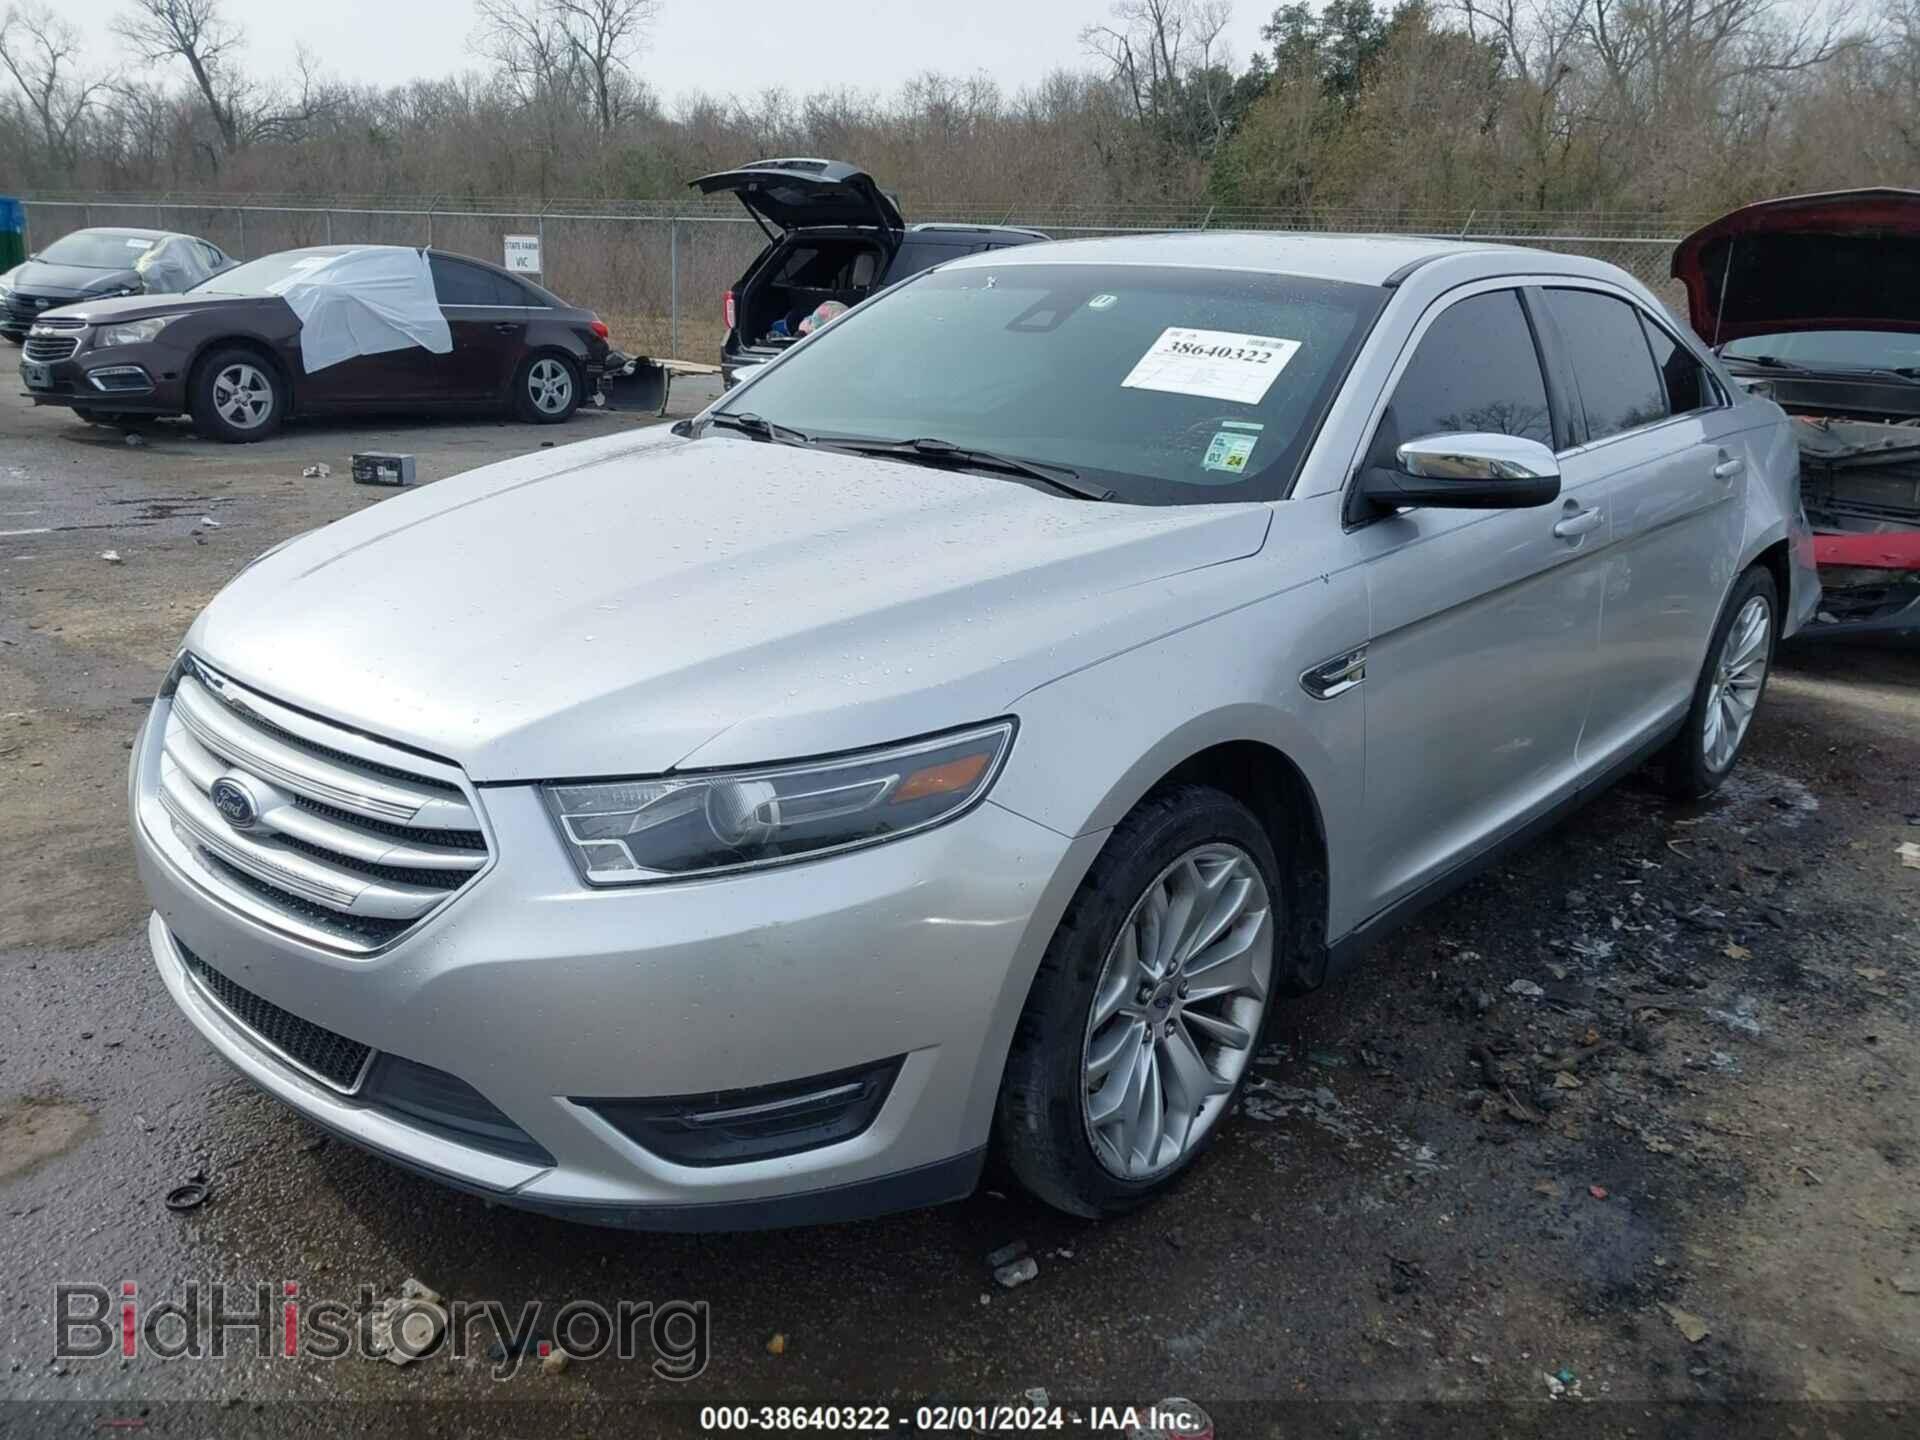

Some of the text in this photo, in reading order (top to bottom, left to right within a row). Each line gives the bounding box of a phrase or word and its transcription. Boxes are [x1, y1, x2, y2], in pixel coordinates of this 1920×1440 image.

[504, 241, 521, 250] STATE
[516, 256, 528, 268] VIC
[1164, 340, 1273, 364] 38640322
[216, 787, 244, 817] Ford
